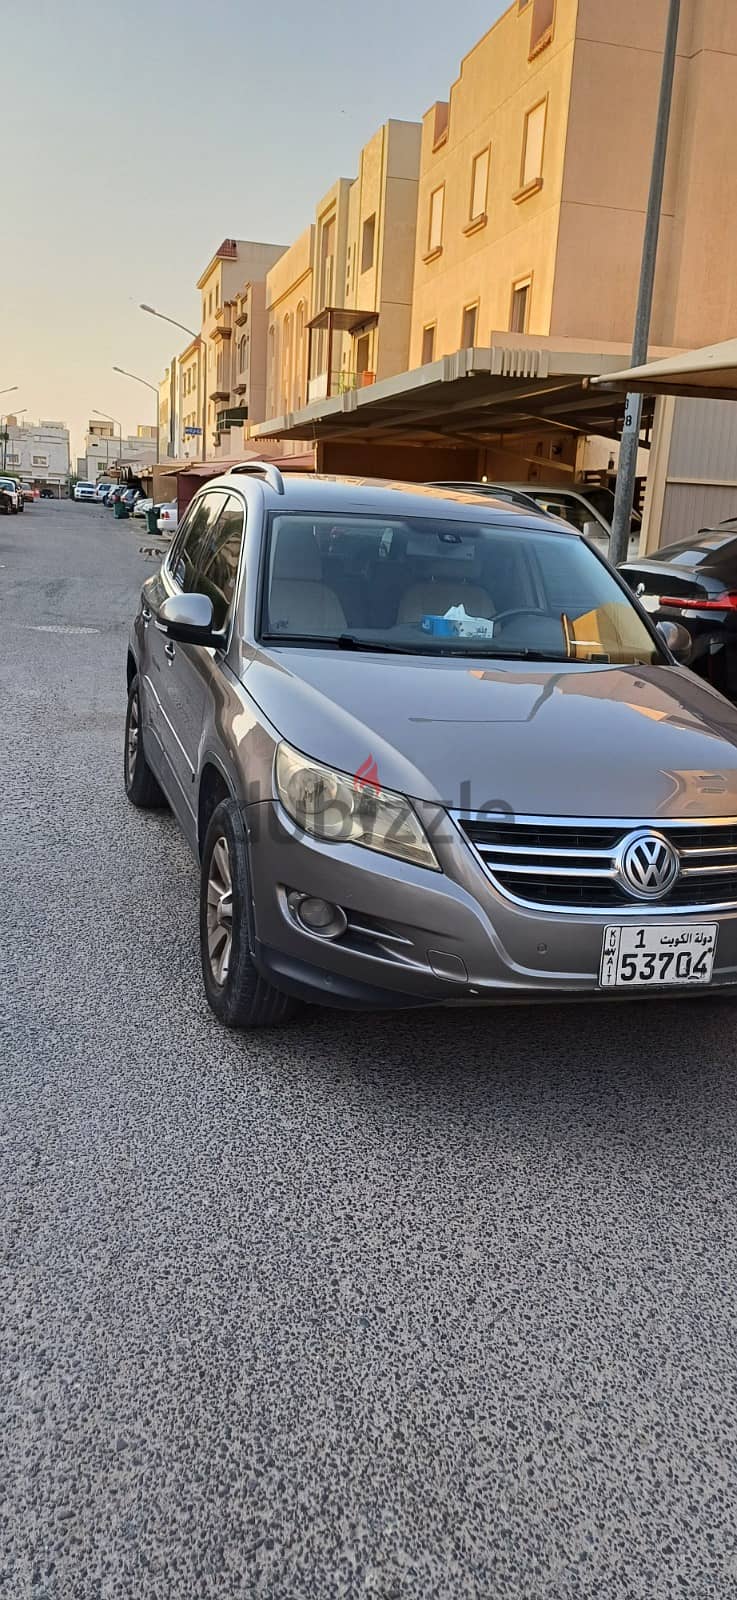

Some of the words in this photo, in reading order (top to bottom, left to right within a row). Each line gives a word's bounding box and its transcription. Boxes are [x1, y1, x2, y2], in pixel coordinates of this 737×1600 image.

[634, 929, 646, 949] 1
[659, 932, 693, 948] الكويت
[694, 931, 713, 946] دولة
[605, 929, 617, 984] KUWAIT
[620, 948, 712, 981] 53704
